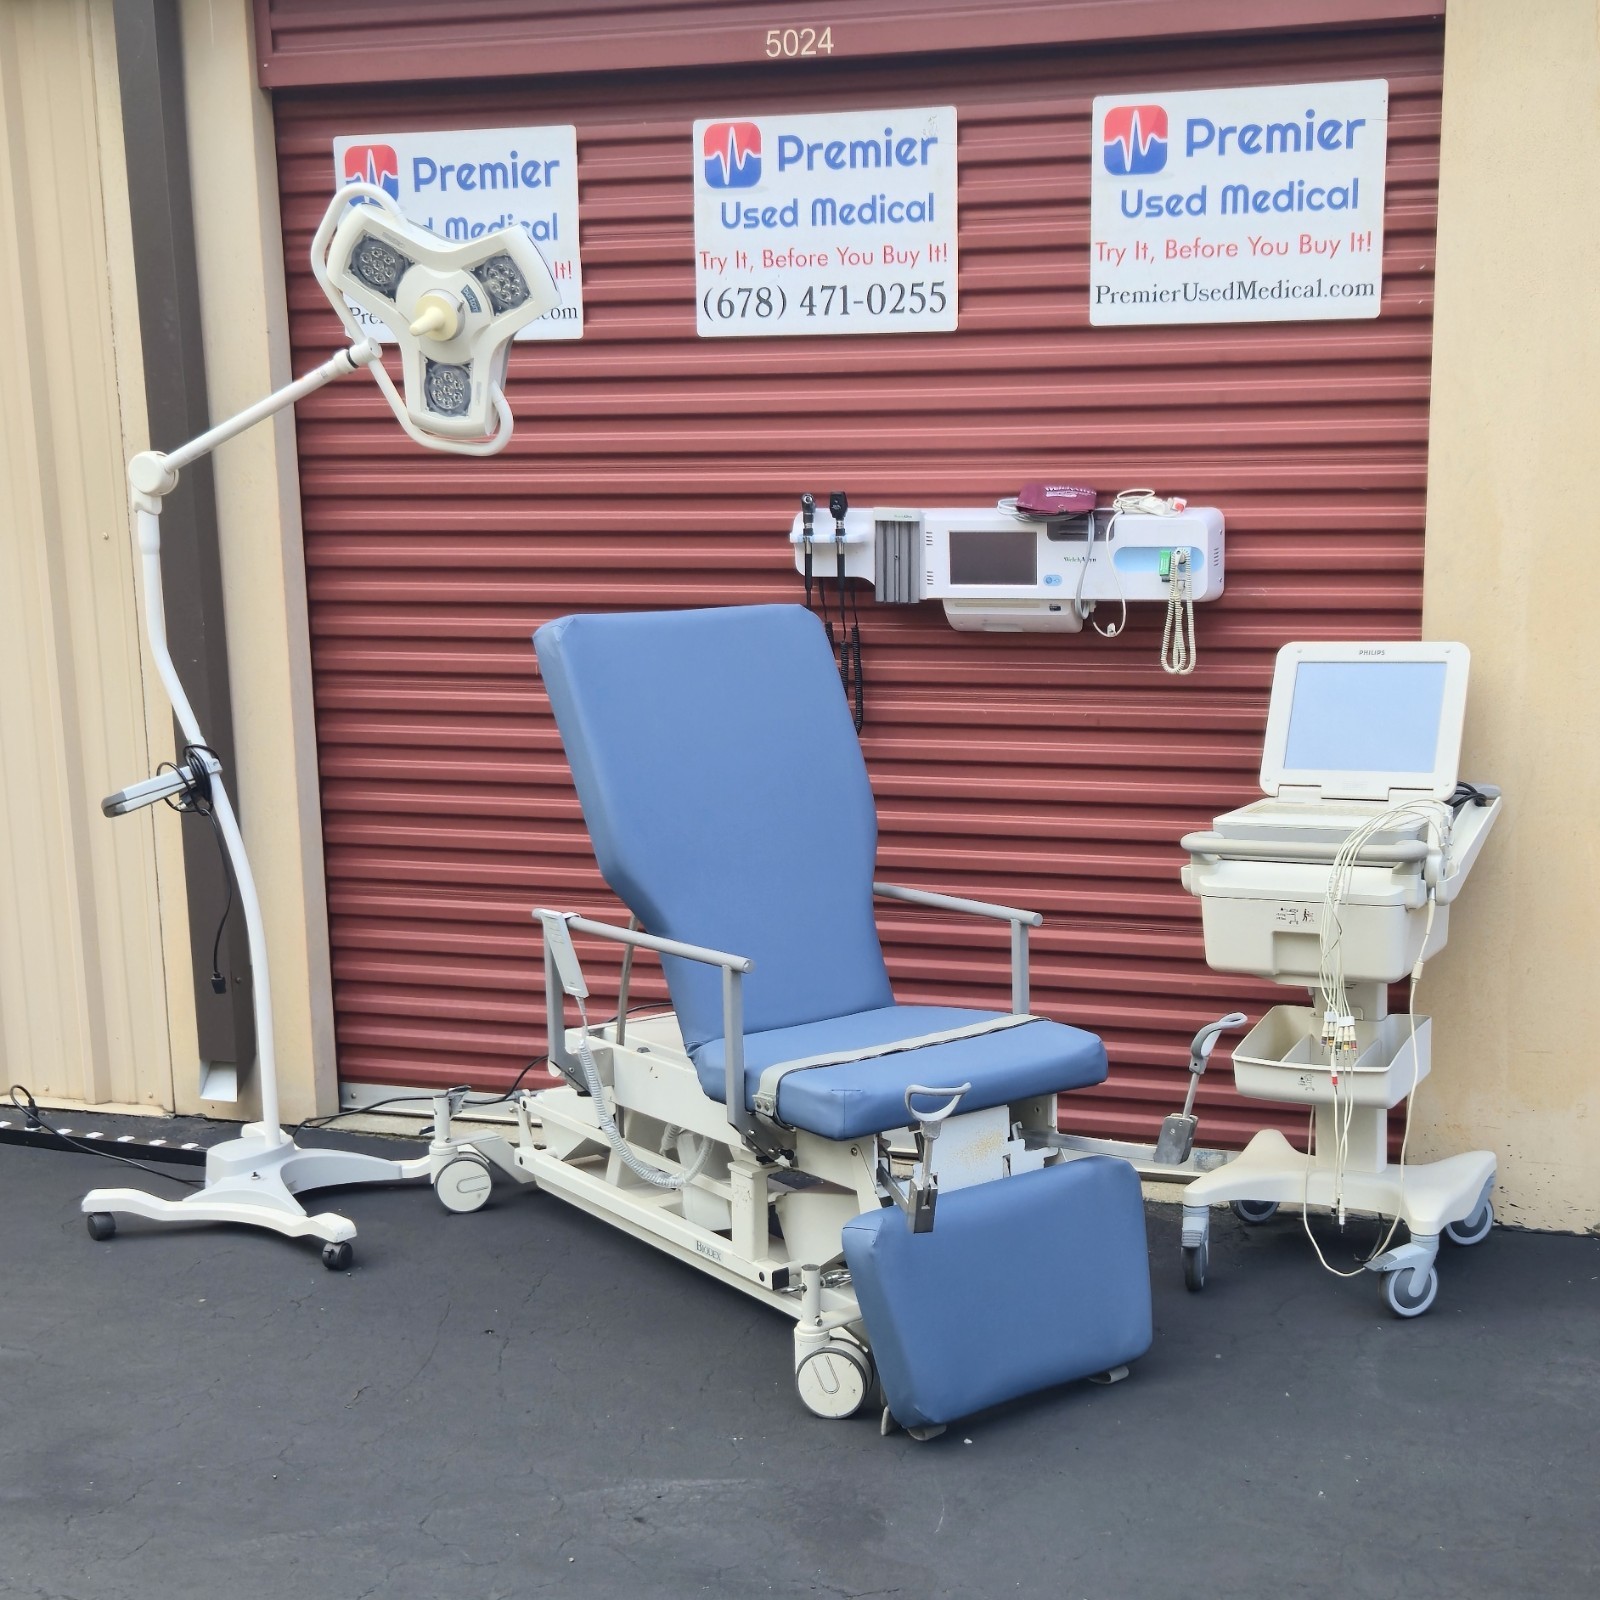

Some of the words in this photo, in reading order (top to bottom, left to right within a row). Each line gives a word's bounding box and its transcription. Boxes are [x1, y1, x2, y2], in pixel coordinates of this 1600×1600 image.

[766, 27, 834, 57] 5024
[777, 127, 938, 172] Premier
[1186, 108, 1366, 157] Premier
[413, 150, 560, 192] Premier
[721, 198, 799, 229] Used
[811, 192, 934, 226] Medical
[1121, 185, 1207, 218] Used
[1220, 177, 1359, 215] Medical
[699, 251, 728, 275] Try
[735, 250, 755, 273] It,
[763, 247, 829, 269] Before
[836, 246, 874, 266] You
[883, 245, 920, 268] Buy
[929, 243, 948, 263] It!
[1095, 241, 1127, 267] Try
[1135, 240, 1155, 264] It,
[1165, 237, 1239, 260] Before
[1248, 235, 1289, 256] You
[1299, 233, 1342, 259] Buy
[1351, 231, 1372, 252] It!
[554, 260, 573, 279] It!
[703, 284, 787, 321] (678)
[799, 280, 947, 317] 471-0255
[1095, 278, 1376, 304] PremierUsedMedical.com
